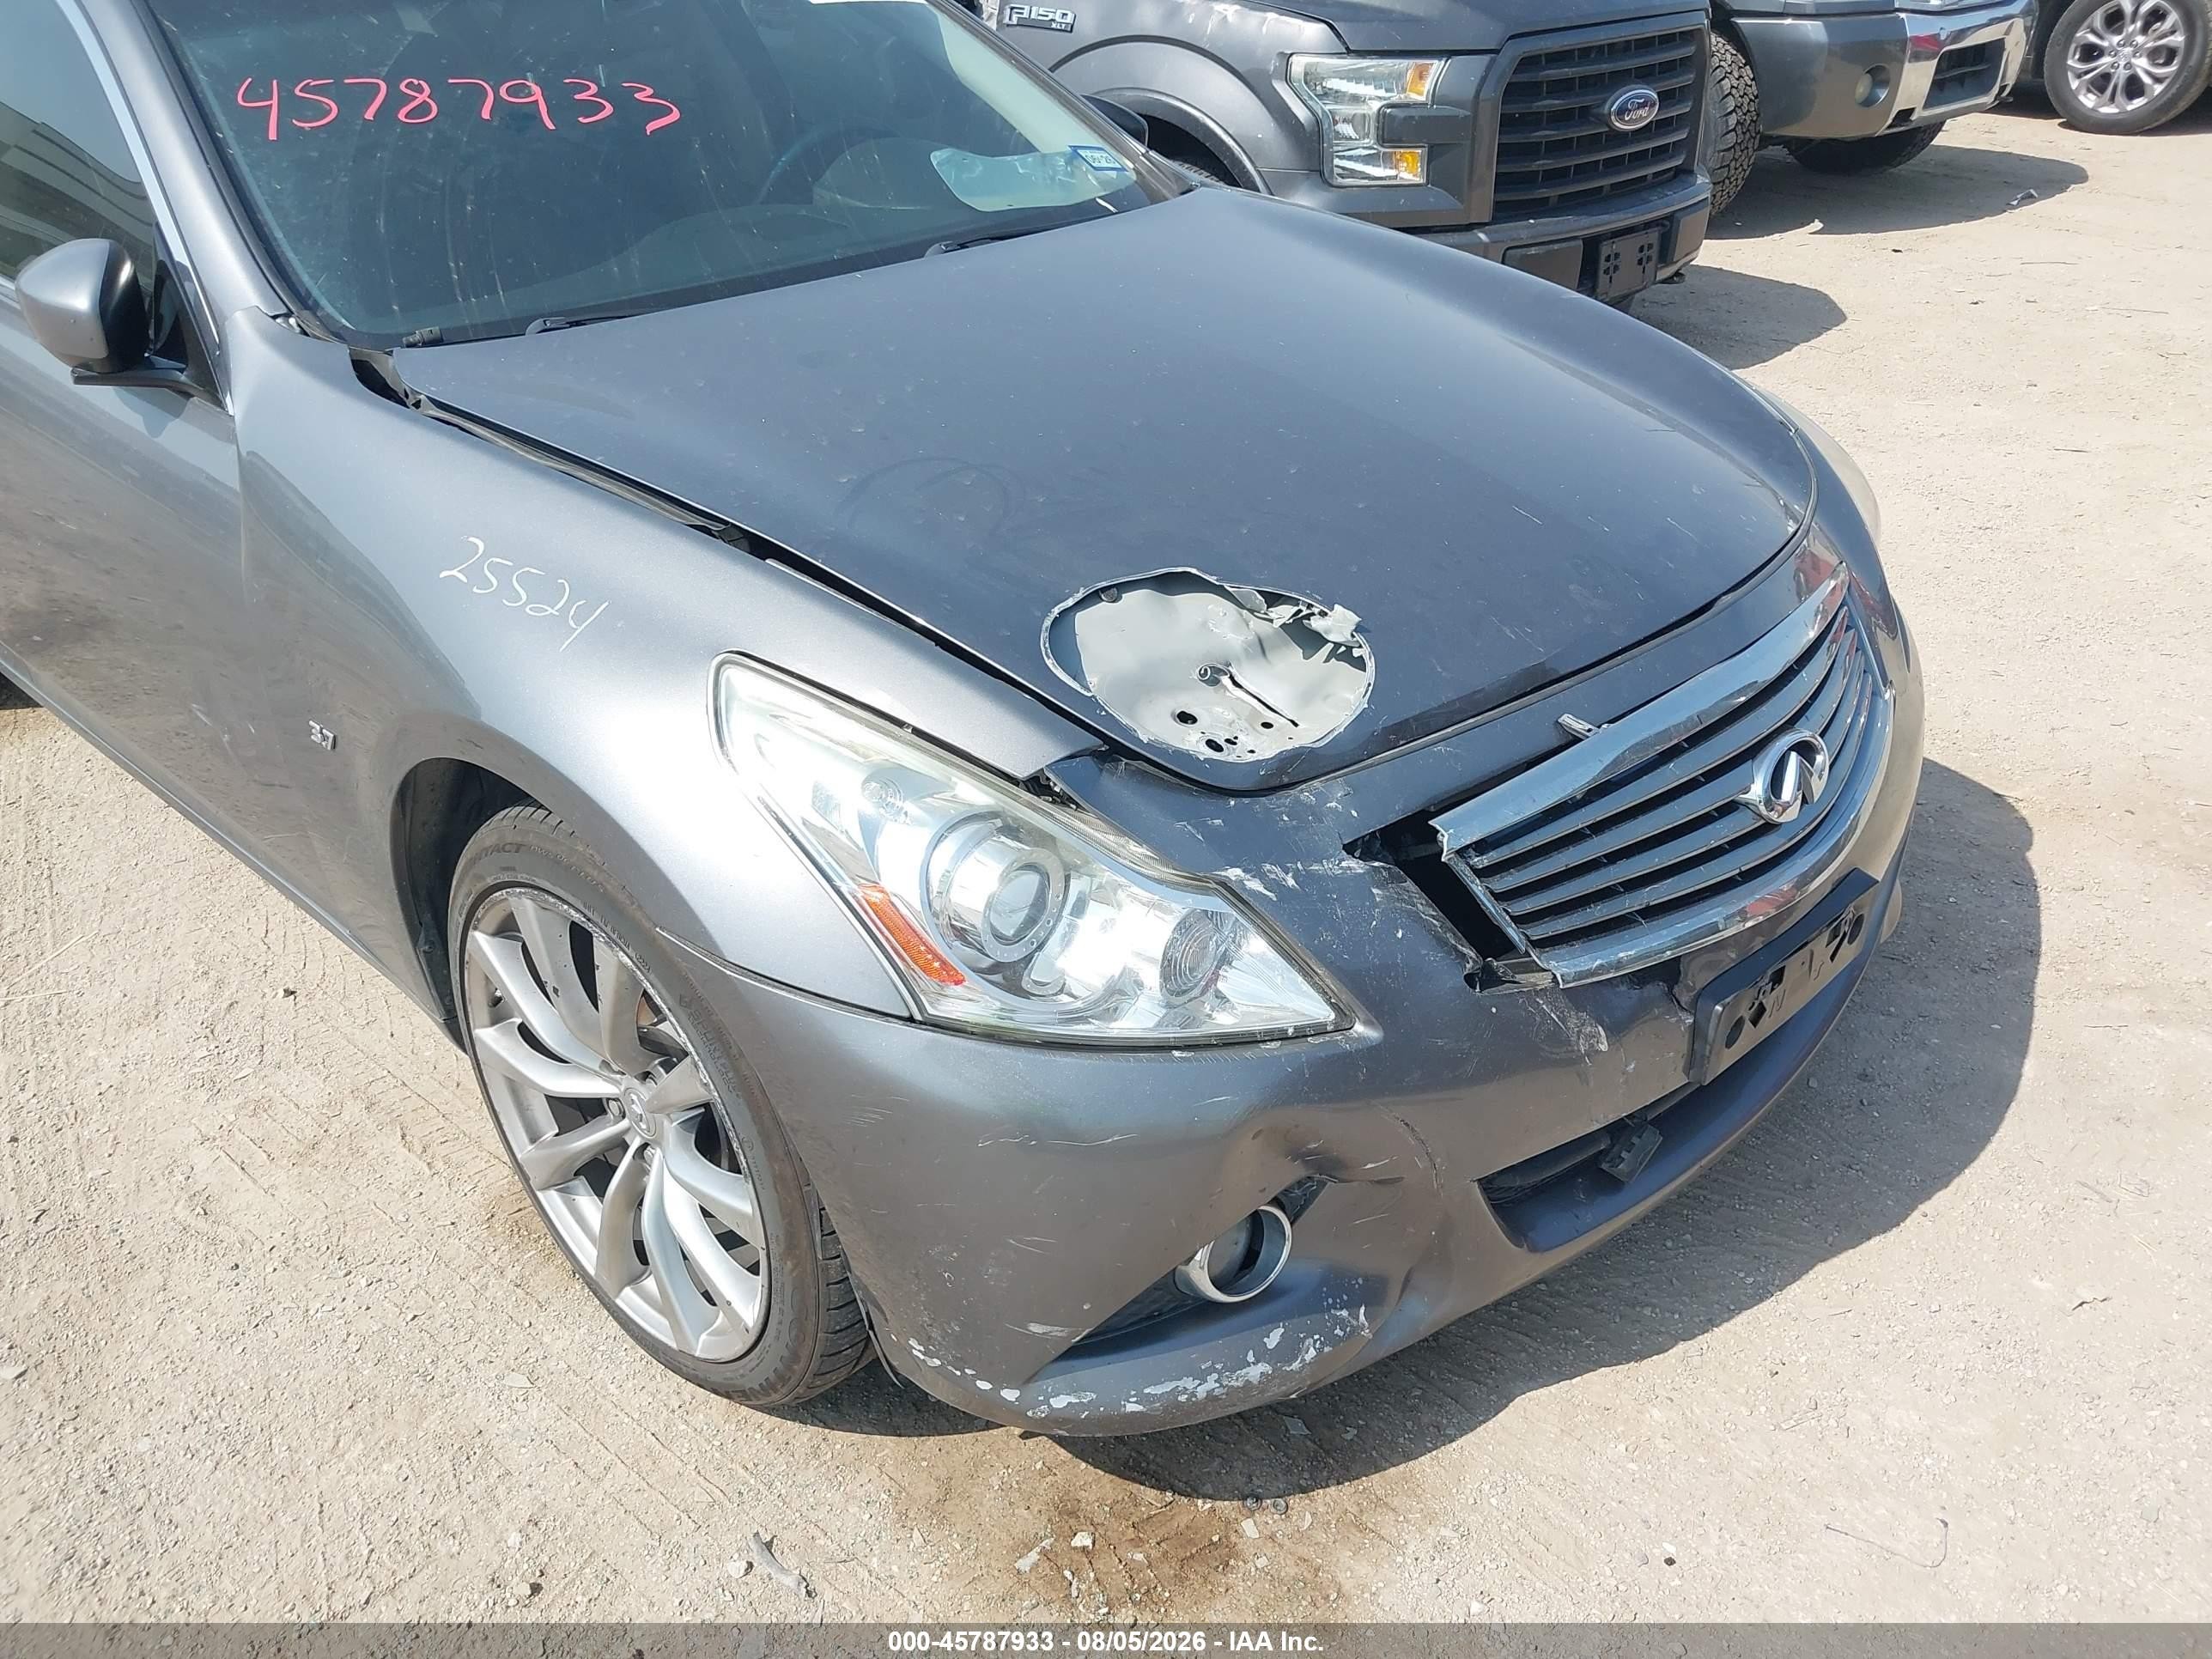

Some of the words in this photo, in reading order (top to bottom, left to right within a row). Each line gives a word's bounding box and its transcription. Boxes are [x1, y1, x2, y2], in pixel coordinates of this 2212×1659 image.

[1050, 21, 1066, 30] XLT
[237, 77, 681, 141] 45787933
[1625, 98, 1650, 121] Ford
[439, 535, 612, 653] 25524
